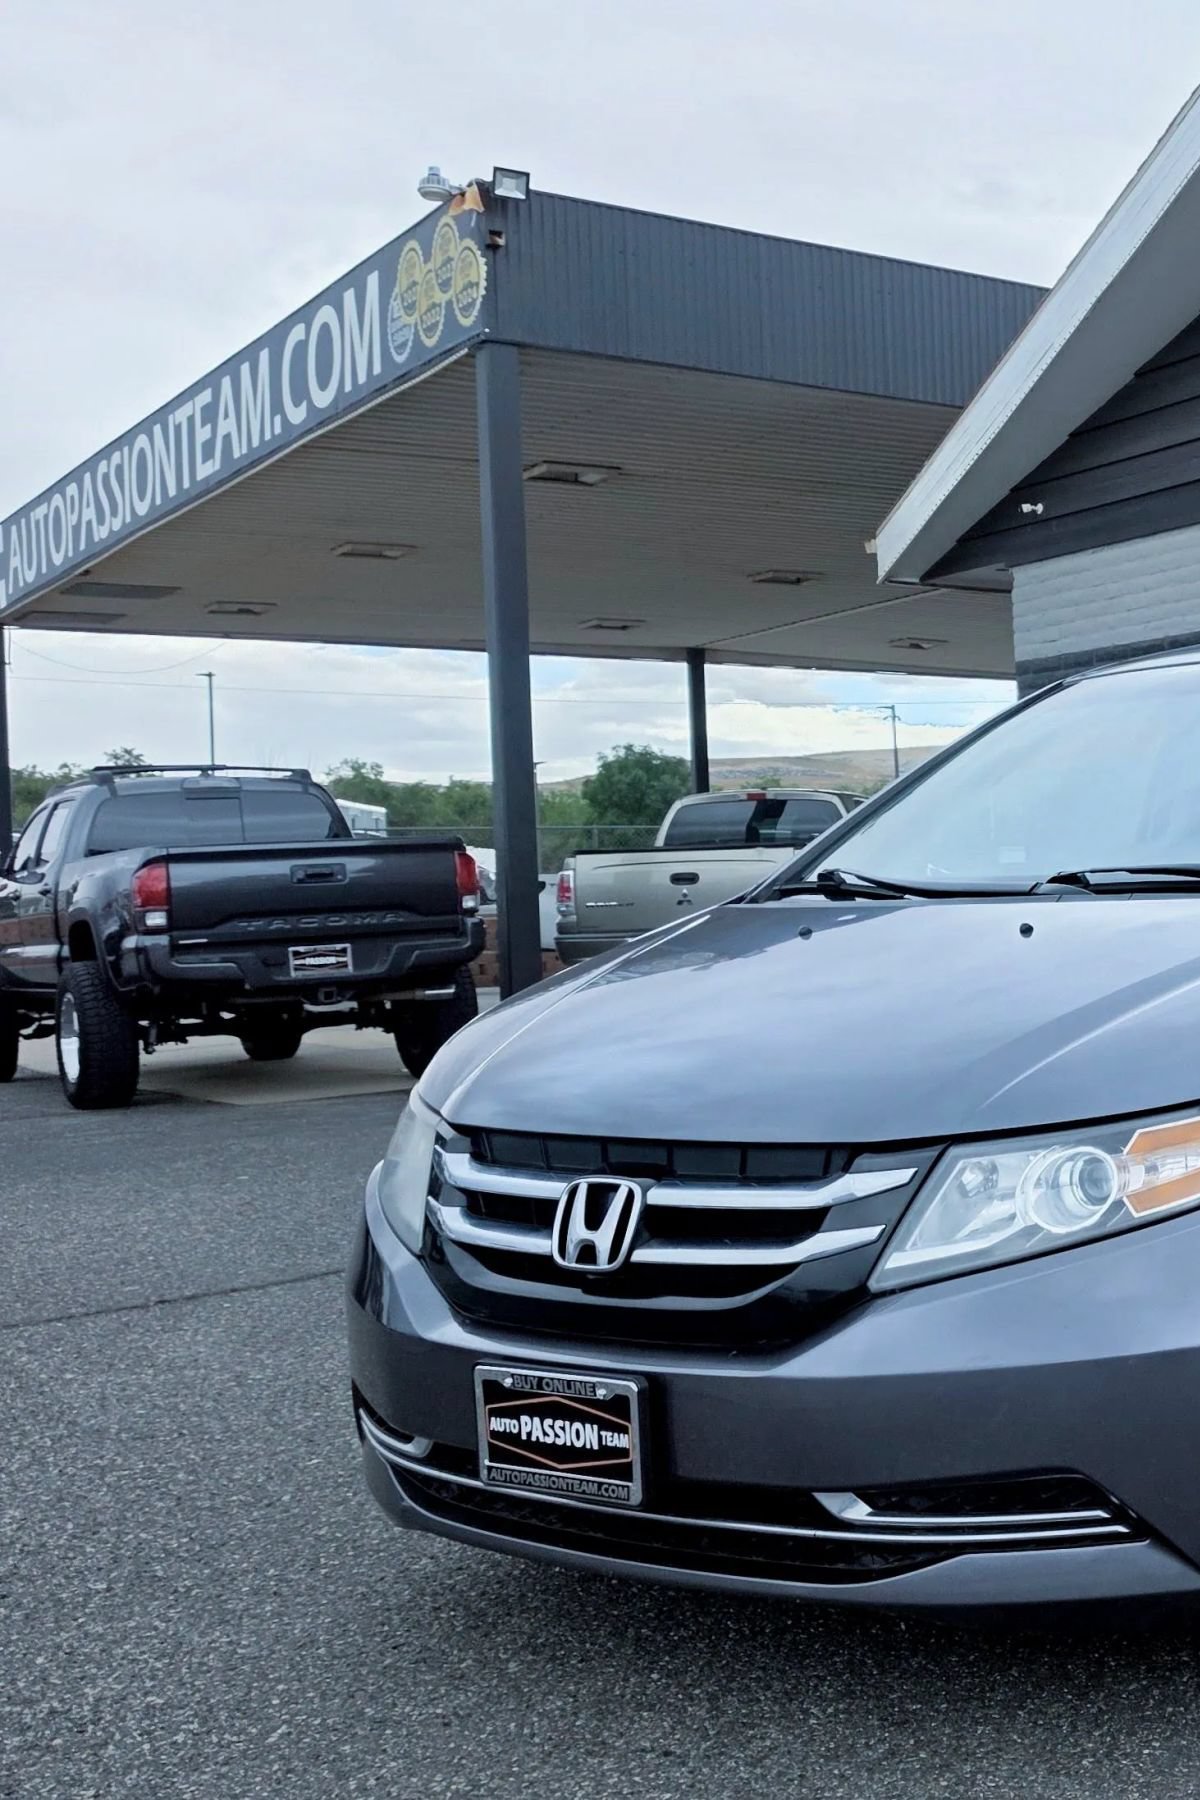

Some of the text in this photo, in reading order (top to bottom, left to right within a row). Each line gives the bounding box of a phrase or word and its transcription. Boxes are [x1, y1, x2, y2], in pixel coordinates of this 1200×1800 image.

[8, 269, 382, 595] AUTOPASSIONTEAM.COM
[237, 913, 404, 931] TACOMA
[512, 1374, 595, 1396] BUY ONLINE
[489, 1415, 630, 1450] AUTO PASSION TEAM
[489, 1468, 629, 1500] AUTOPASSIONTEAM.COM
